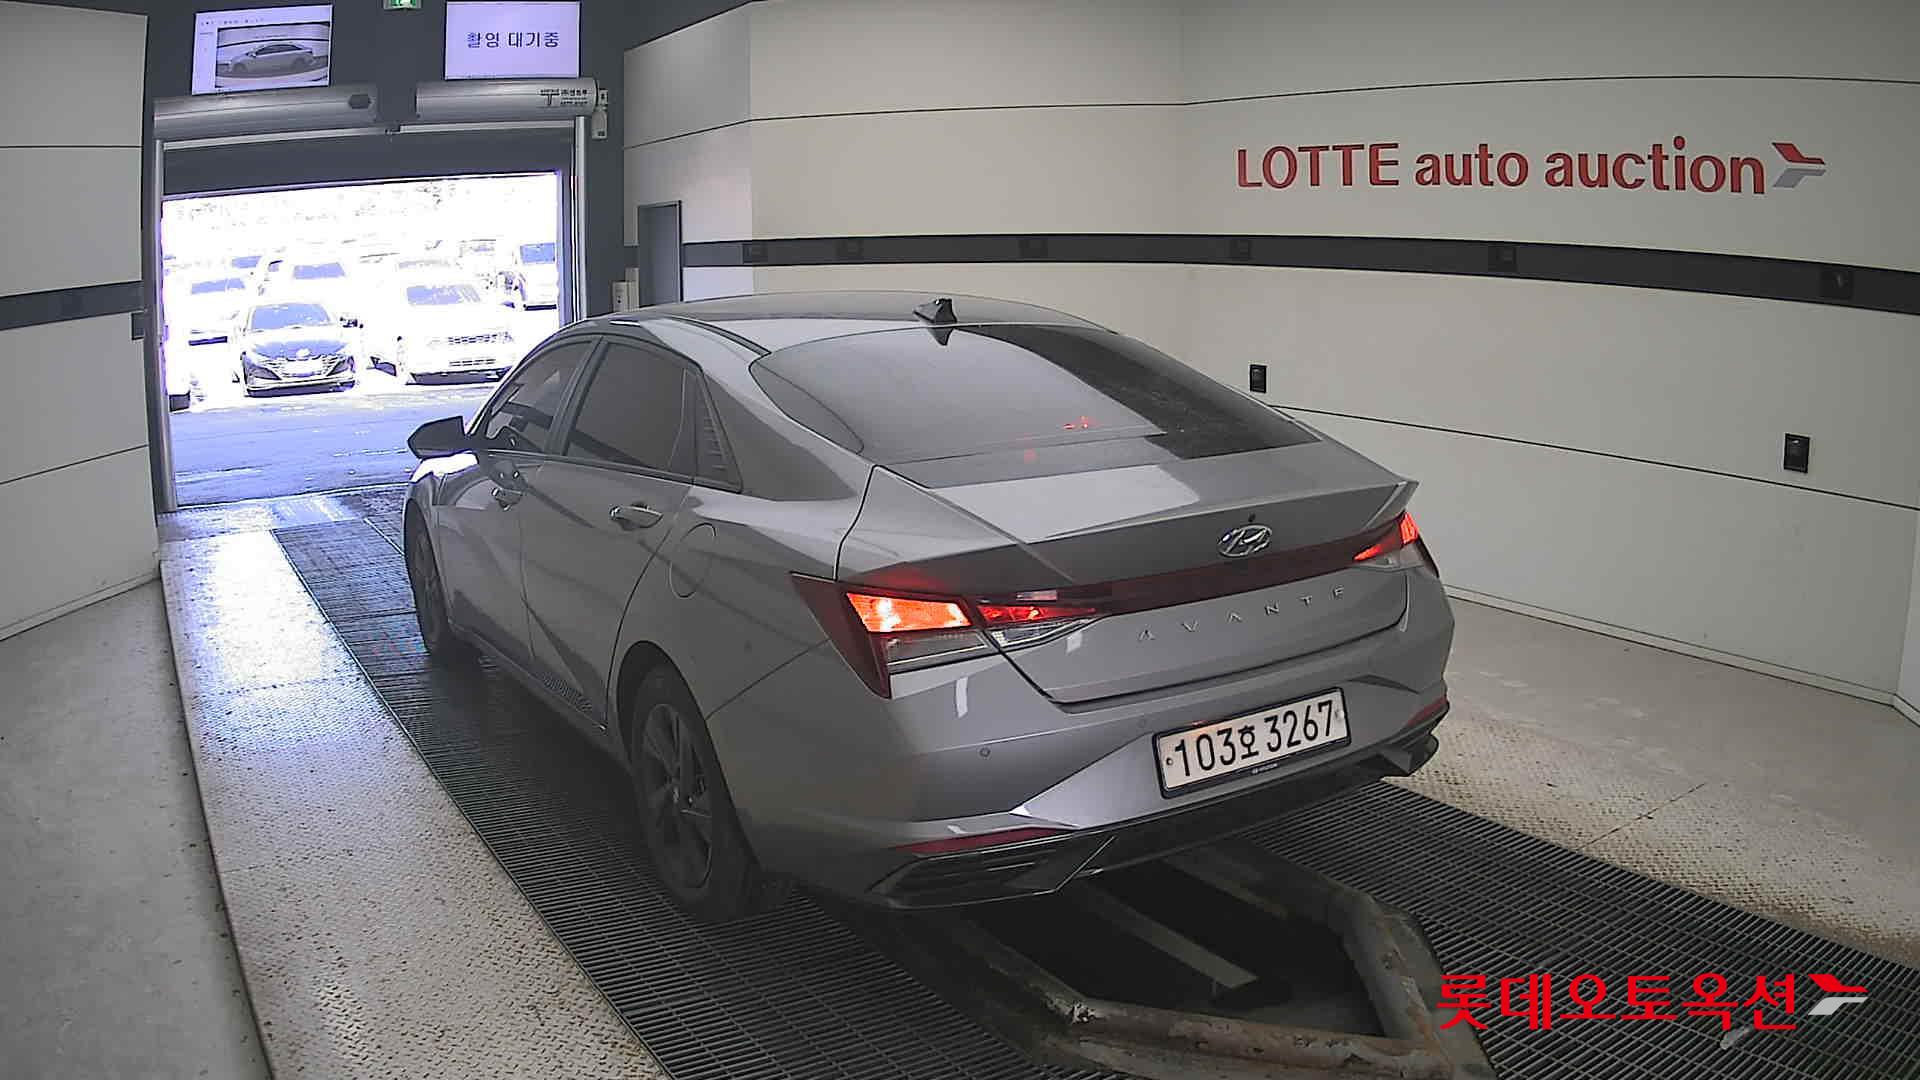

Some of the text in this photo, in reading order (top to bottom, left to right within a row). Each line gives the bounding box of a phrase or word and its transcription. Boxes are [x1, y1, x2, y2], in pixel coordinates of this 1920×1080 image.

[508, 32, 560, 48] 대기중
[1237, 135, 1766, 195] LOTTE auto auction
[1138, 585, 1345, 642] AVANTE
[1264, 700, 1332, 752] 3267
